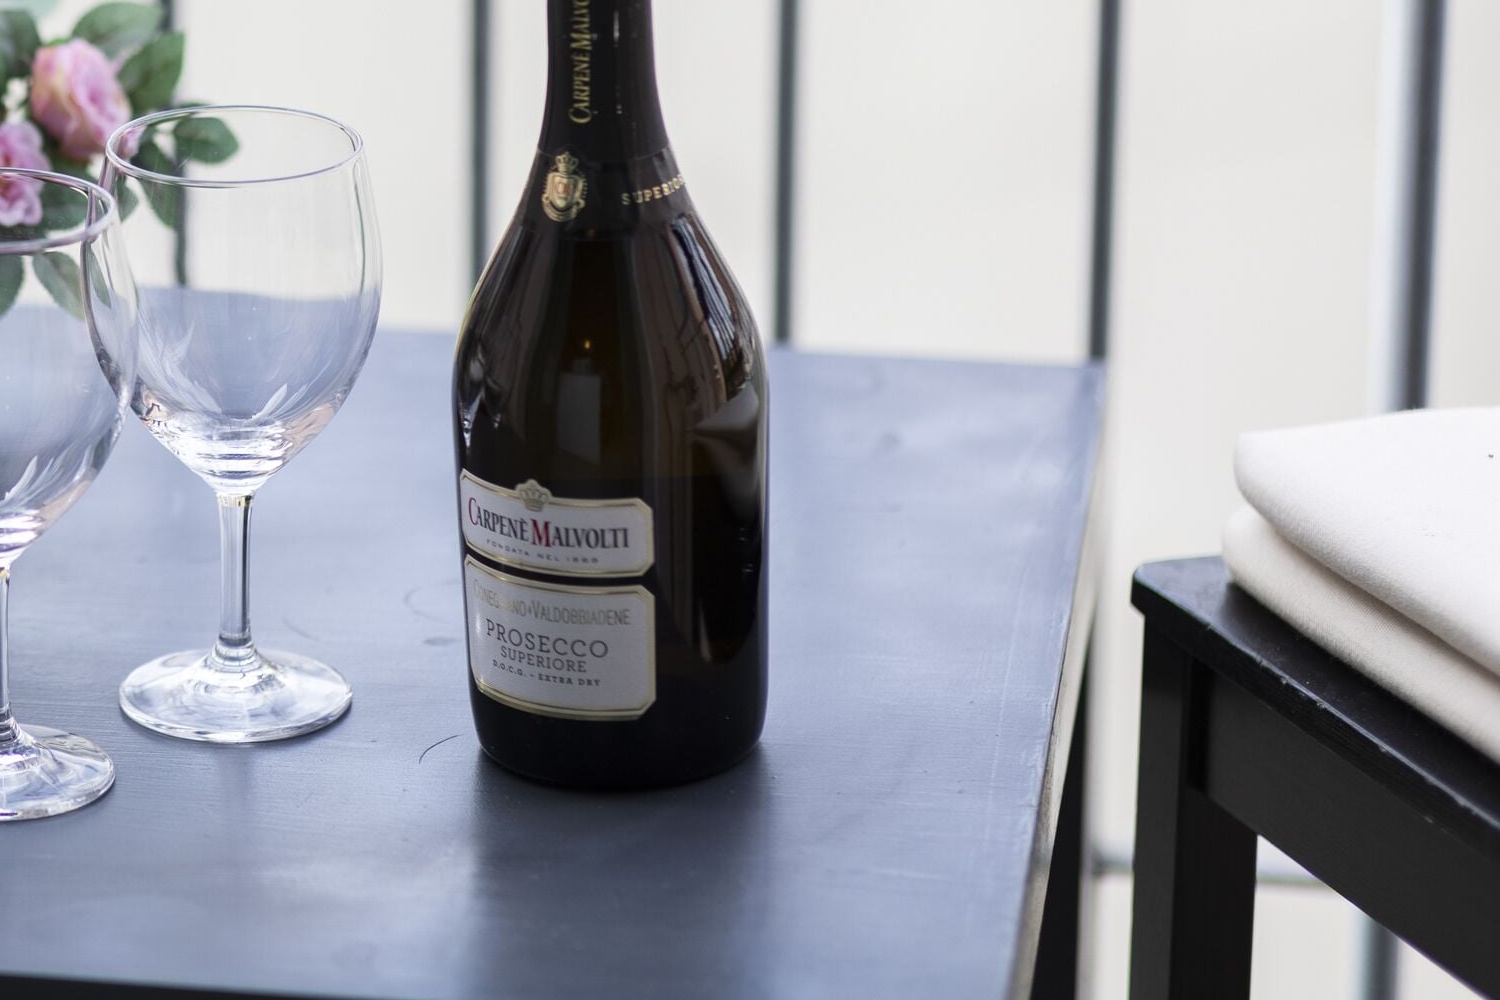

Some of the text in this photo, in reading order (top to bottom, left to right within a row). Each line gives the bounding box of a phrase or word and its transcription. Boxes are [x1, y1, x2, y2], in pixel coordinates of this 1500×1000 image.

[530, 517, 630, 549] MALVOLTI
[486, 538, 531, 556] FONDATA
[537, 553, 561, 562] NEL
[486, 618, 609, 658] PROSECCO
[492, 659, 528, 678] D.O.C.G.
[538, 673, 574, 686] EXTRA
[578, 678, 601, 687] DRY
[500, 645, 588, 673] SUPERIORE
